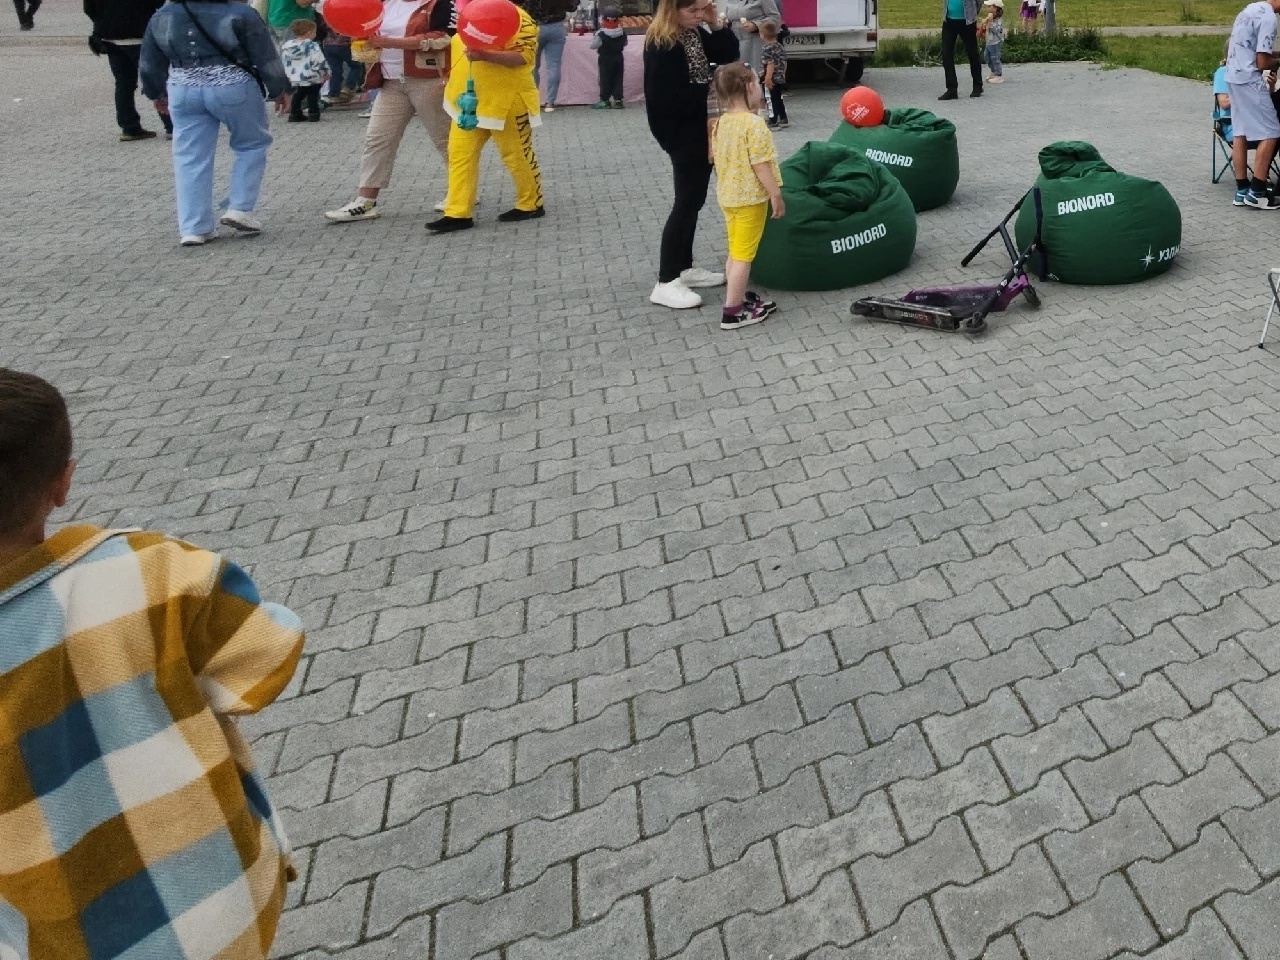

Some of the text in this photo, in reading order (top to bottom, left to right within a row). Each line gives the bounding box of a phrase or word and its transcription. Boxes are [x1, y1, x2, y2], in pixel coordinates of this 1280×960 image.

[865, 148, 913, 167] BIONORD
[1057, 192, 1115, 215] BIONORD
[831, 223, 887, 254] BIONORD
